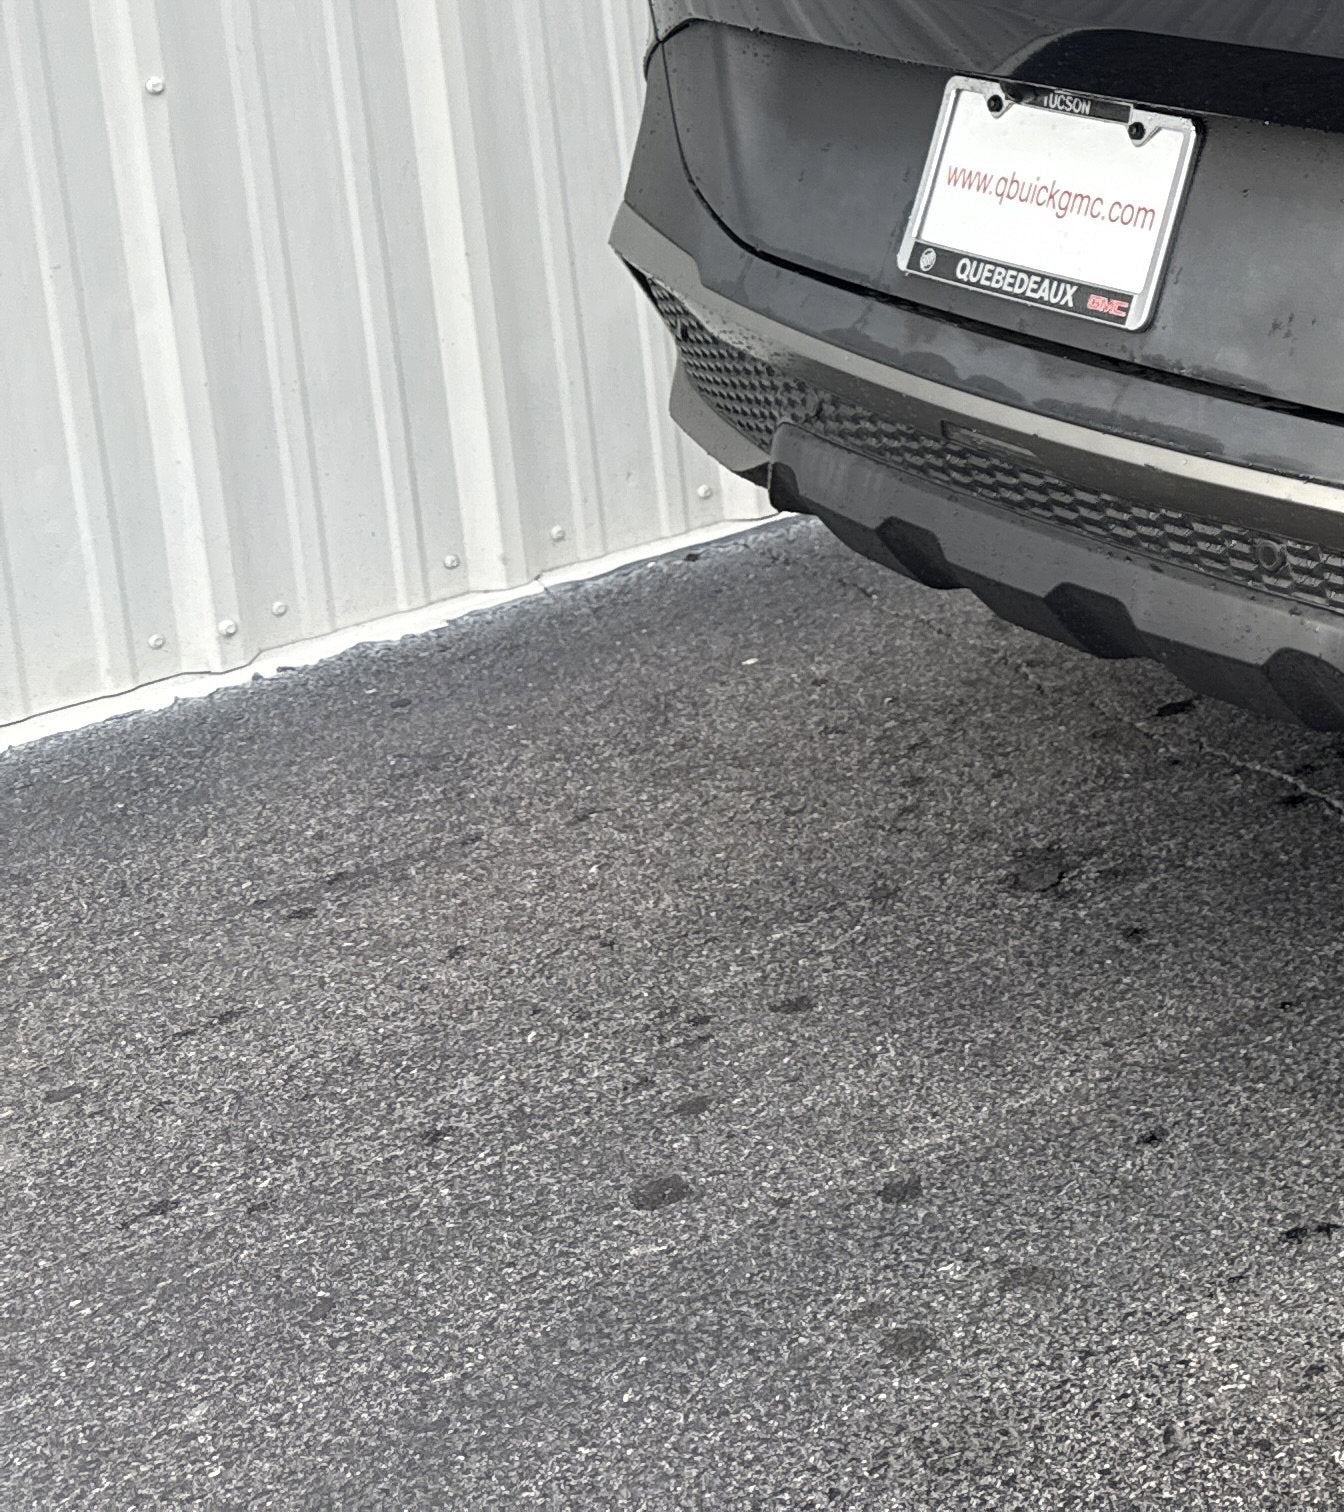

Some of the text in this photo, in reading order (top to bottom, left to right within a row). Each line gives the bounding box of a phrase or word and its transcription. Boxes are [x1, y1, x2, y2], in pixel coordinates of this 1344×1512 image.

[946, 165, 1156, 231] www.qbuickgmc.com
[956, 257, 1130, 318] QUEBEDEAUX GMC
